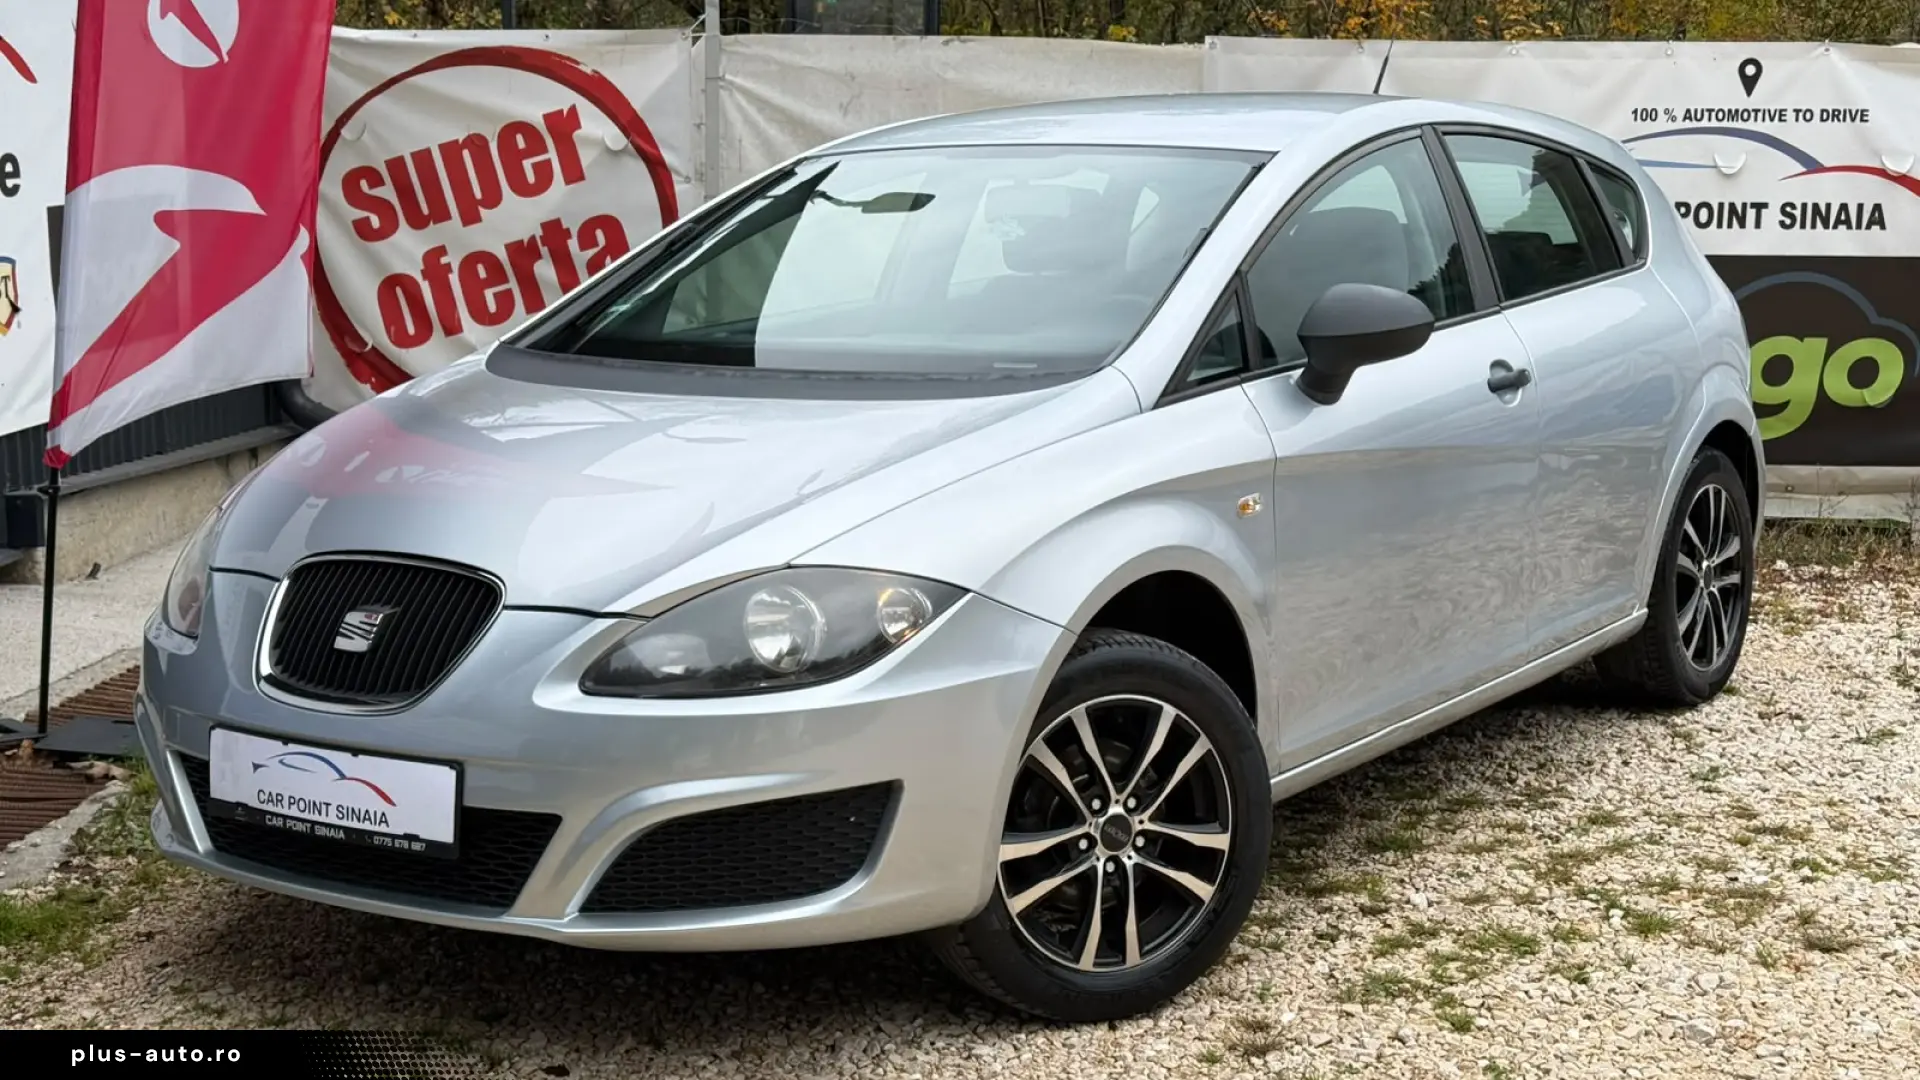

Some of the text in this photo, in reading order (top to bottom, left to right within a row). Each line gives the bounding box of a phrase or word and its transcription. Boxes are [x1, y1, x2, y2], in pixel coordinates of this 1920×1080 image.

[1631, 108, 1869, 123] 100 % AUTOMOTIVE TO DRIVE
[341, 104, 586, 242] super
[1778, 202, 1887, 231] SINAIA
[377, 213, 630, 348] oferta
[257, 789, 390, 828] CAR POINT SINAIA
[265, 815, 284, 828] CAR
[287, 819, 312, 834] POINT
[314, 825, 345, 840] SINAIA
